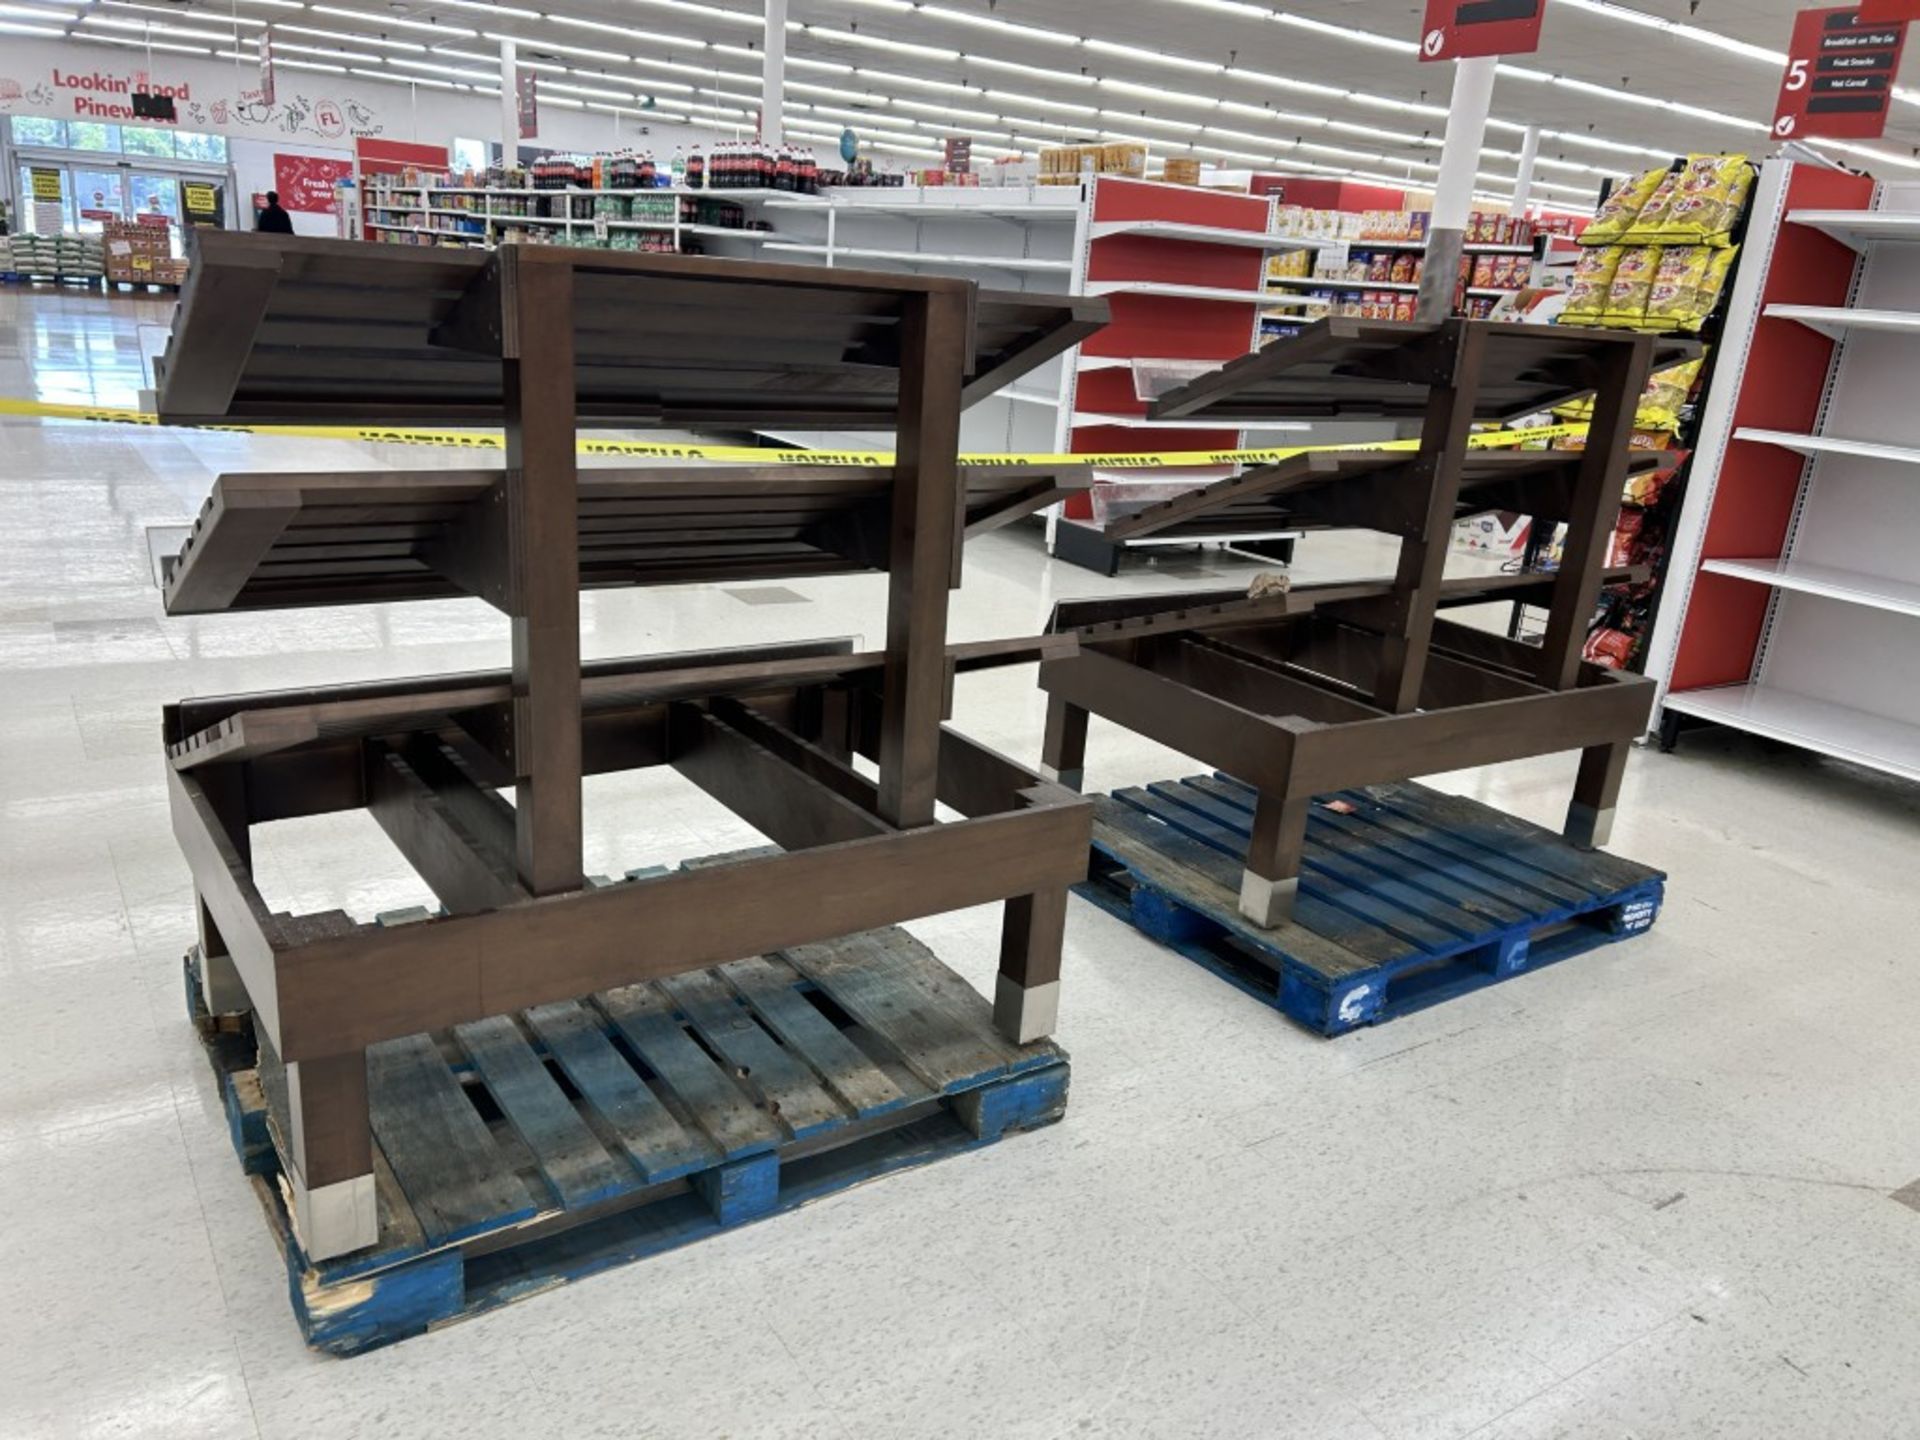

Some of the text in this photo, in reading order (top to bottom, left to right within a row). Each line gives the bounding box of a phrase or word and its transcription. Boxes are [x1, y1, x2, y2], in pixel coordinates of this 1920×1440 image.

[1883, 34, 1895, 44] Go
[1832, 57, 1875, 67] Fruit Snacks
[53, 68, 131, 94] Lookin'
[1785, 59, 1810, 91] 5
[1844, 78, 1869, 88] Cereal
[320, 111, 340, 126] FL
[303, 177, 329, 189] Fresh
